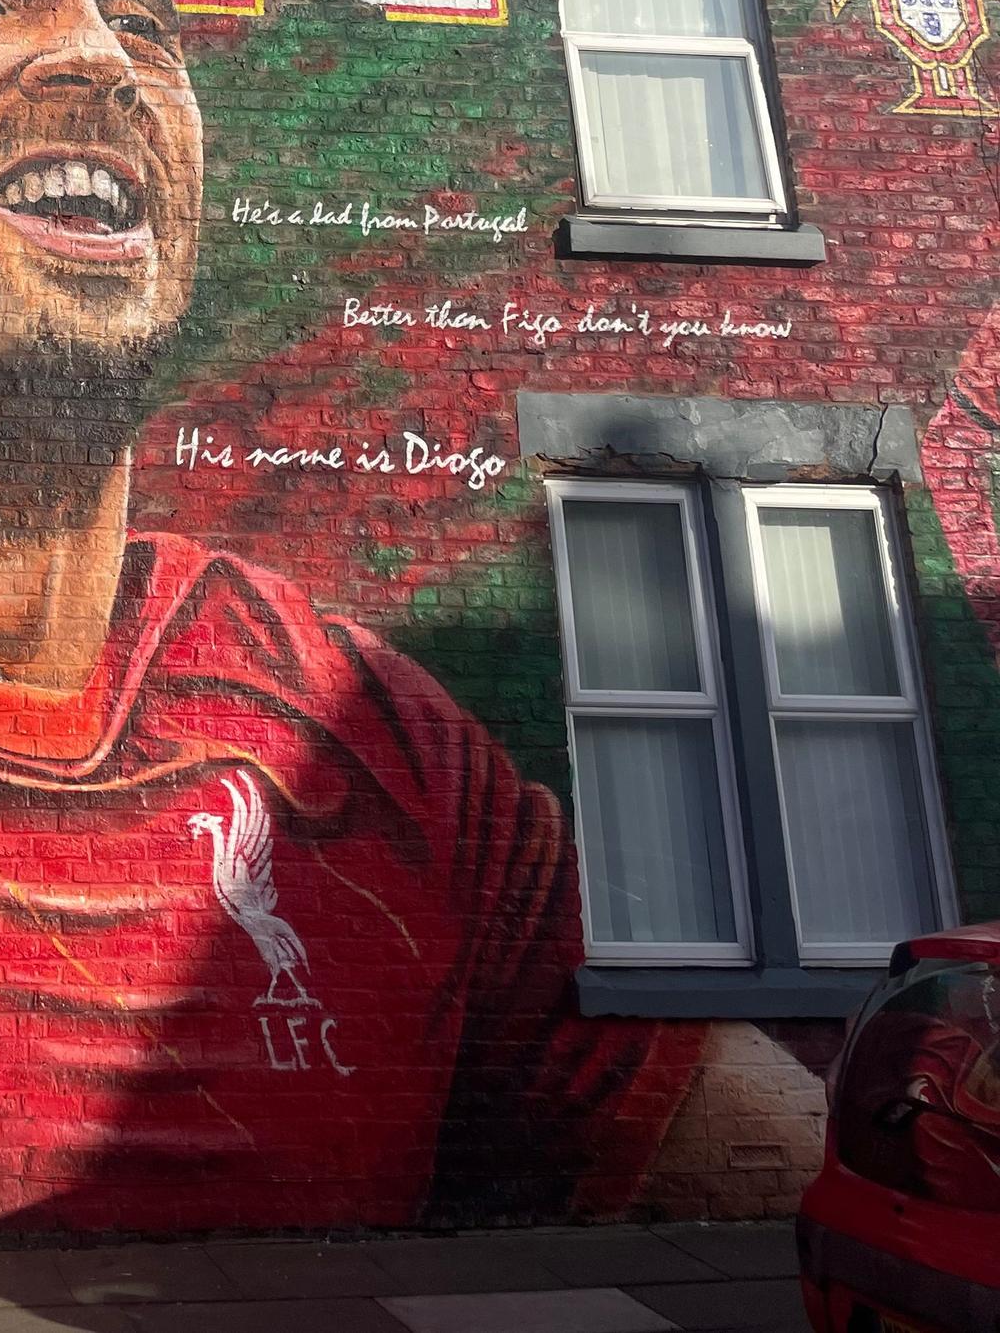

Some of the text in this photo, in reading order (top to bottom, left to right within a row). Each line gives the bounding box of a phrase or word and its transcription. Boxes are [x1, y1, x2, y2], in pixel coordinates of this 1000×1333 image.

[232, 197, 529, 243] He's a lad from Portugal
[342, 297, 793, 347] Better than Figo don't you know
[176, 427, 507, 491] His name is Diogo
[257, 1017, 357, 1076] LFC
